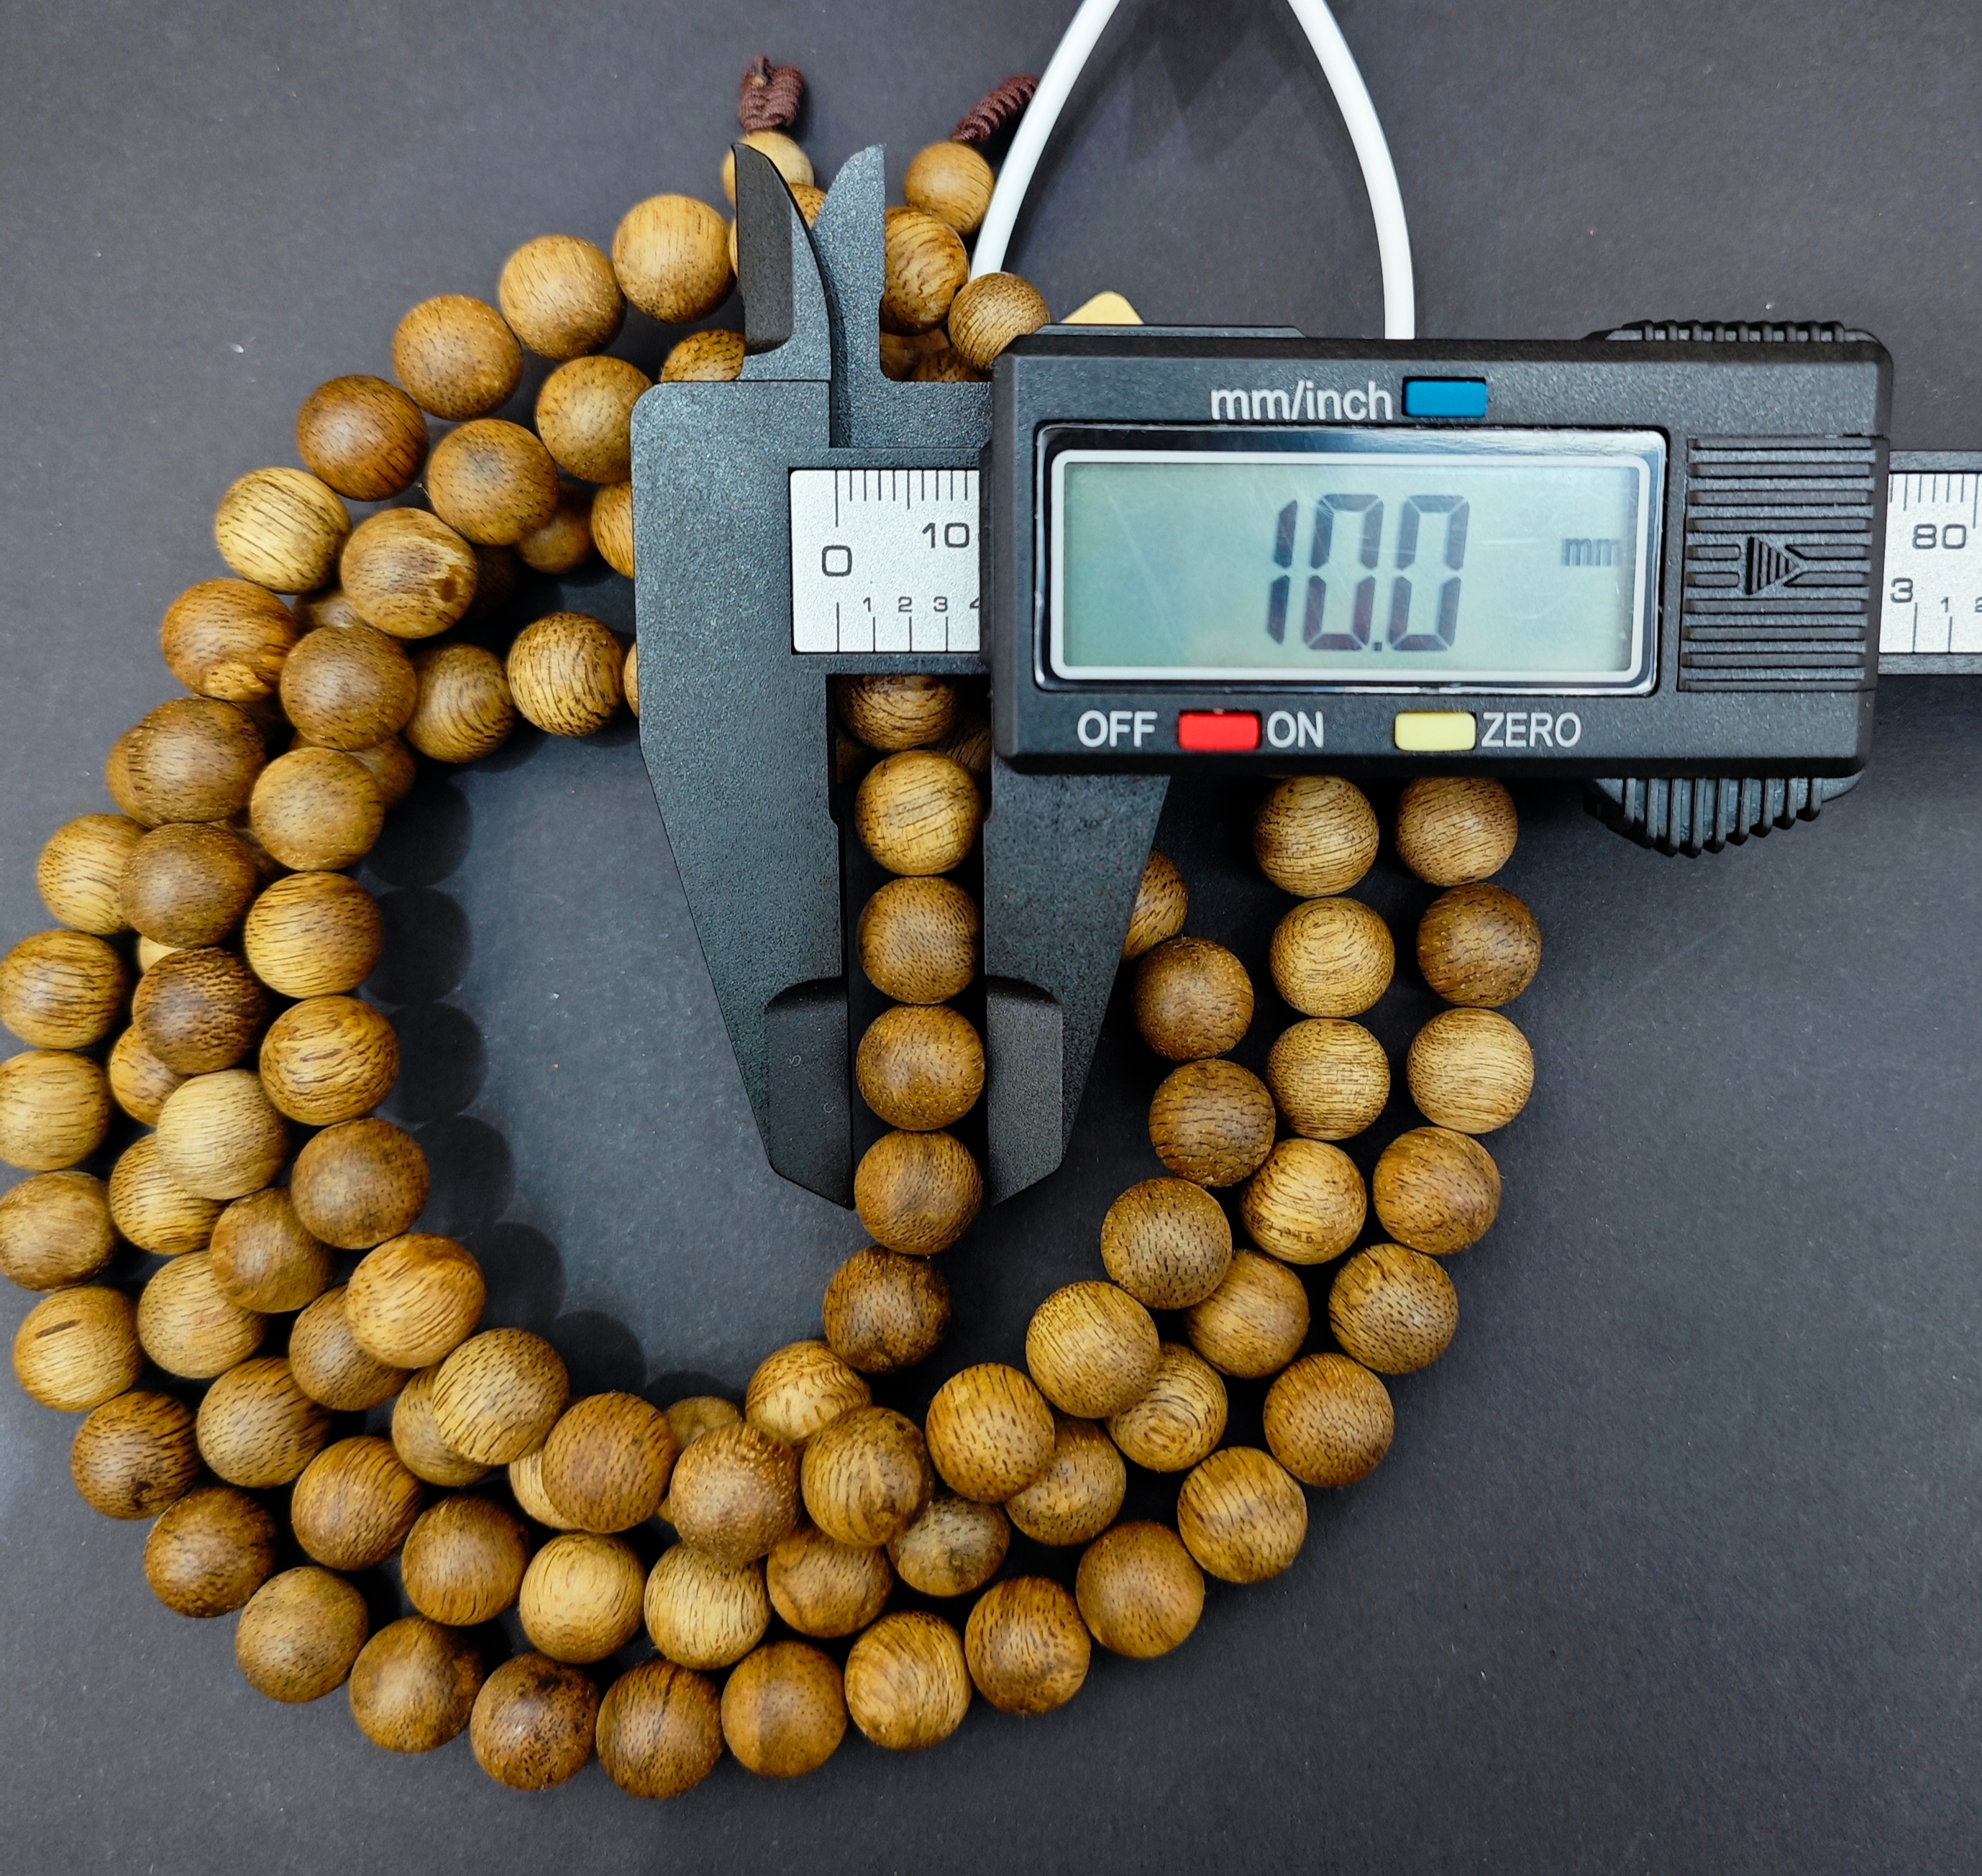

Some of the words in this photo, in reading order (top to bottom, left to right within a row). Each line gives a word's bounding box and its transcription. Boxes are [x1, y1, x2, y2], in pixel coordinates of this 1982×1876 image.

[1210, 380, 1393, 421] mm/inch
[922, 522, 970, 549] 10
[1912, 523, 1967, 549] 80
[822, 545, 852, 577] 0
[1561, 536, 1621, 567] mm
[1266, 493, 1471, 652] 10.0
[862, 597, 871, 613] 1
[898, 596, 913, 612] 2
[933, 596, 949, 612] 3
[1890, 577, 1914, 603] 3
[1940, 596, 1949, 613] 1
[1077, 710, 1158, 748] OFF
[1266, 710, 1325, 748] ON
[1481, 711, 1582, 749] ZERO
